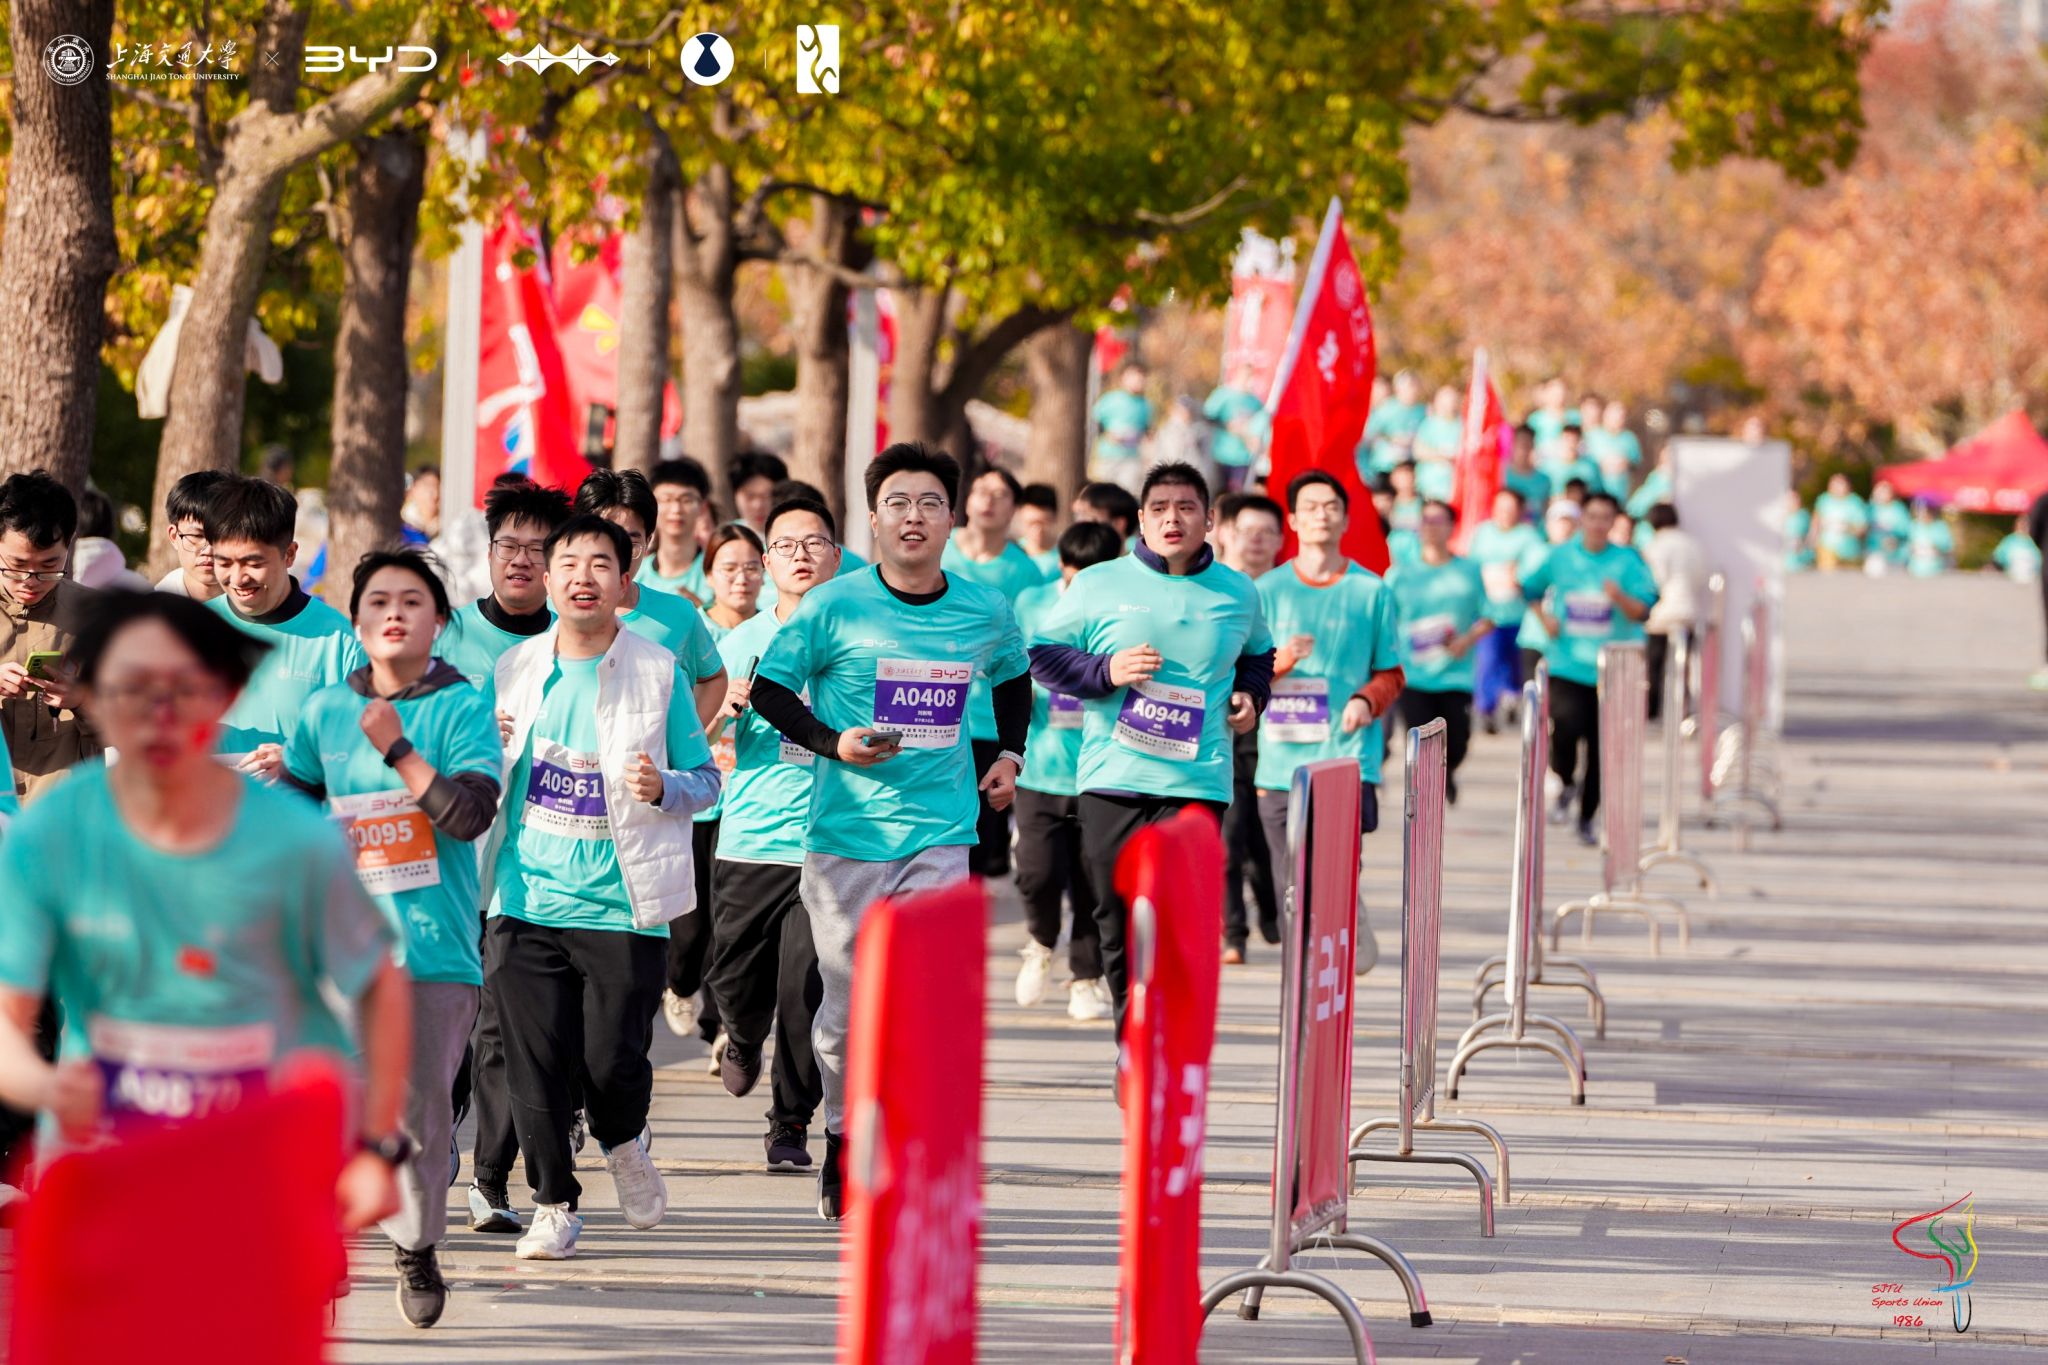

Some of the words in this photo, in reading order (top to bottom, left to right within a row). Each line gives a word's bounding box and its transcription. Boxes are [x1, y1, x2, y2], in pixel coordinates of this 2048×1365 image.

[863, 639, 898, 649] BYD
[930, 668, 969, 680] BYD
[891, 687, 957, 707] A0408
[1168, 691, 1202, 704] BYD
[1132, 697, 1191, 728] A0944
[571, 758, 599, 769] BY
[539, 769, 601, 798] A0961
